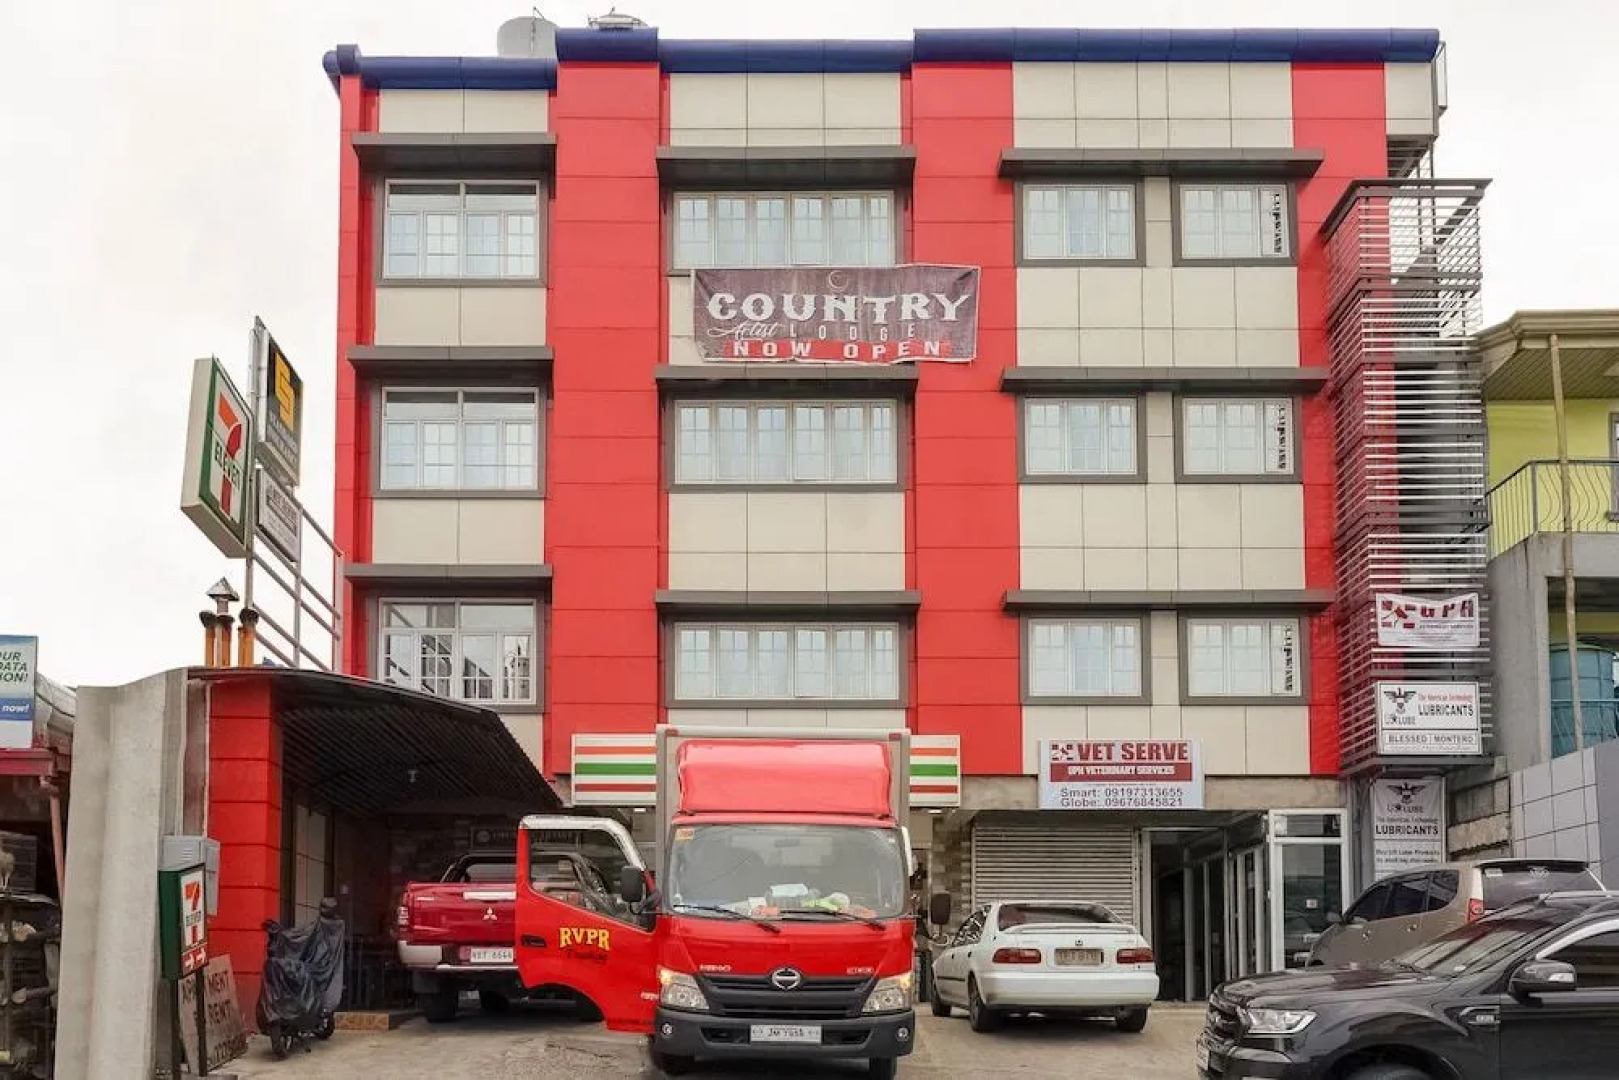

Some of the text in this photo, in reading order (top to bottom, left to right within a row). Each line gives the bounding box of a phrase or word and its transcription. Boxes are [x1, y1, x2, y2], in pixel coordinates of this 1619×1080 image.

[707, 293, 971, 324] COUNTRY
[789, 323, 916, 342] LODGE
[732, 340, 943, 359] NOW OPEN
[1418, 704, 1474, 716] LUBRICANTS
[1388, 734, 1428, 744] BLESSED
[1077, 742, 1188, 761] VET SERVE
[1060, 787, 1101, 798] Smart:
[1060, 797, 1101, 808] Globe:
[1376, 825, 1439, 835] LUBRICANTS
[558, 927, 611, 951] RVPR
